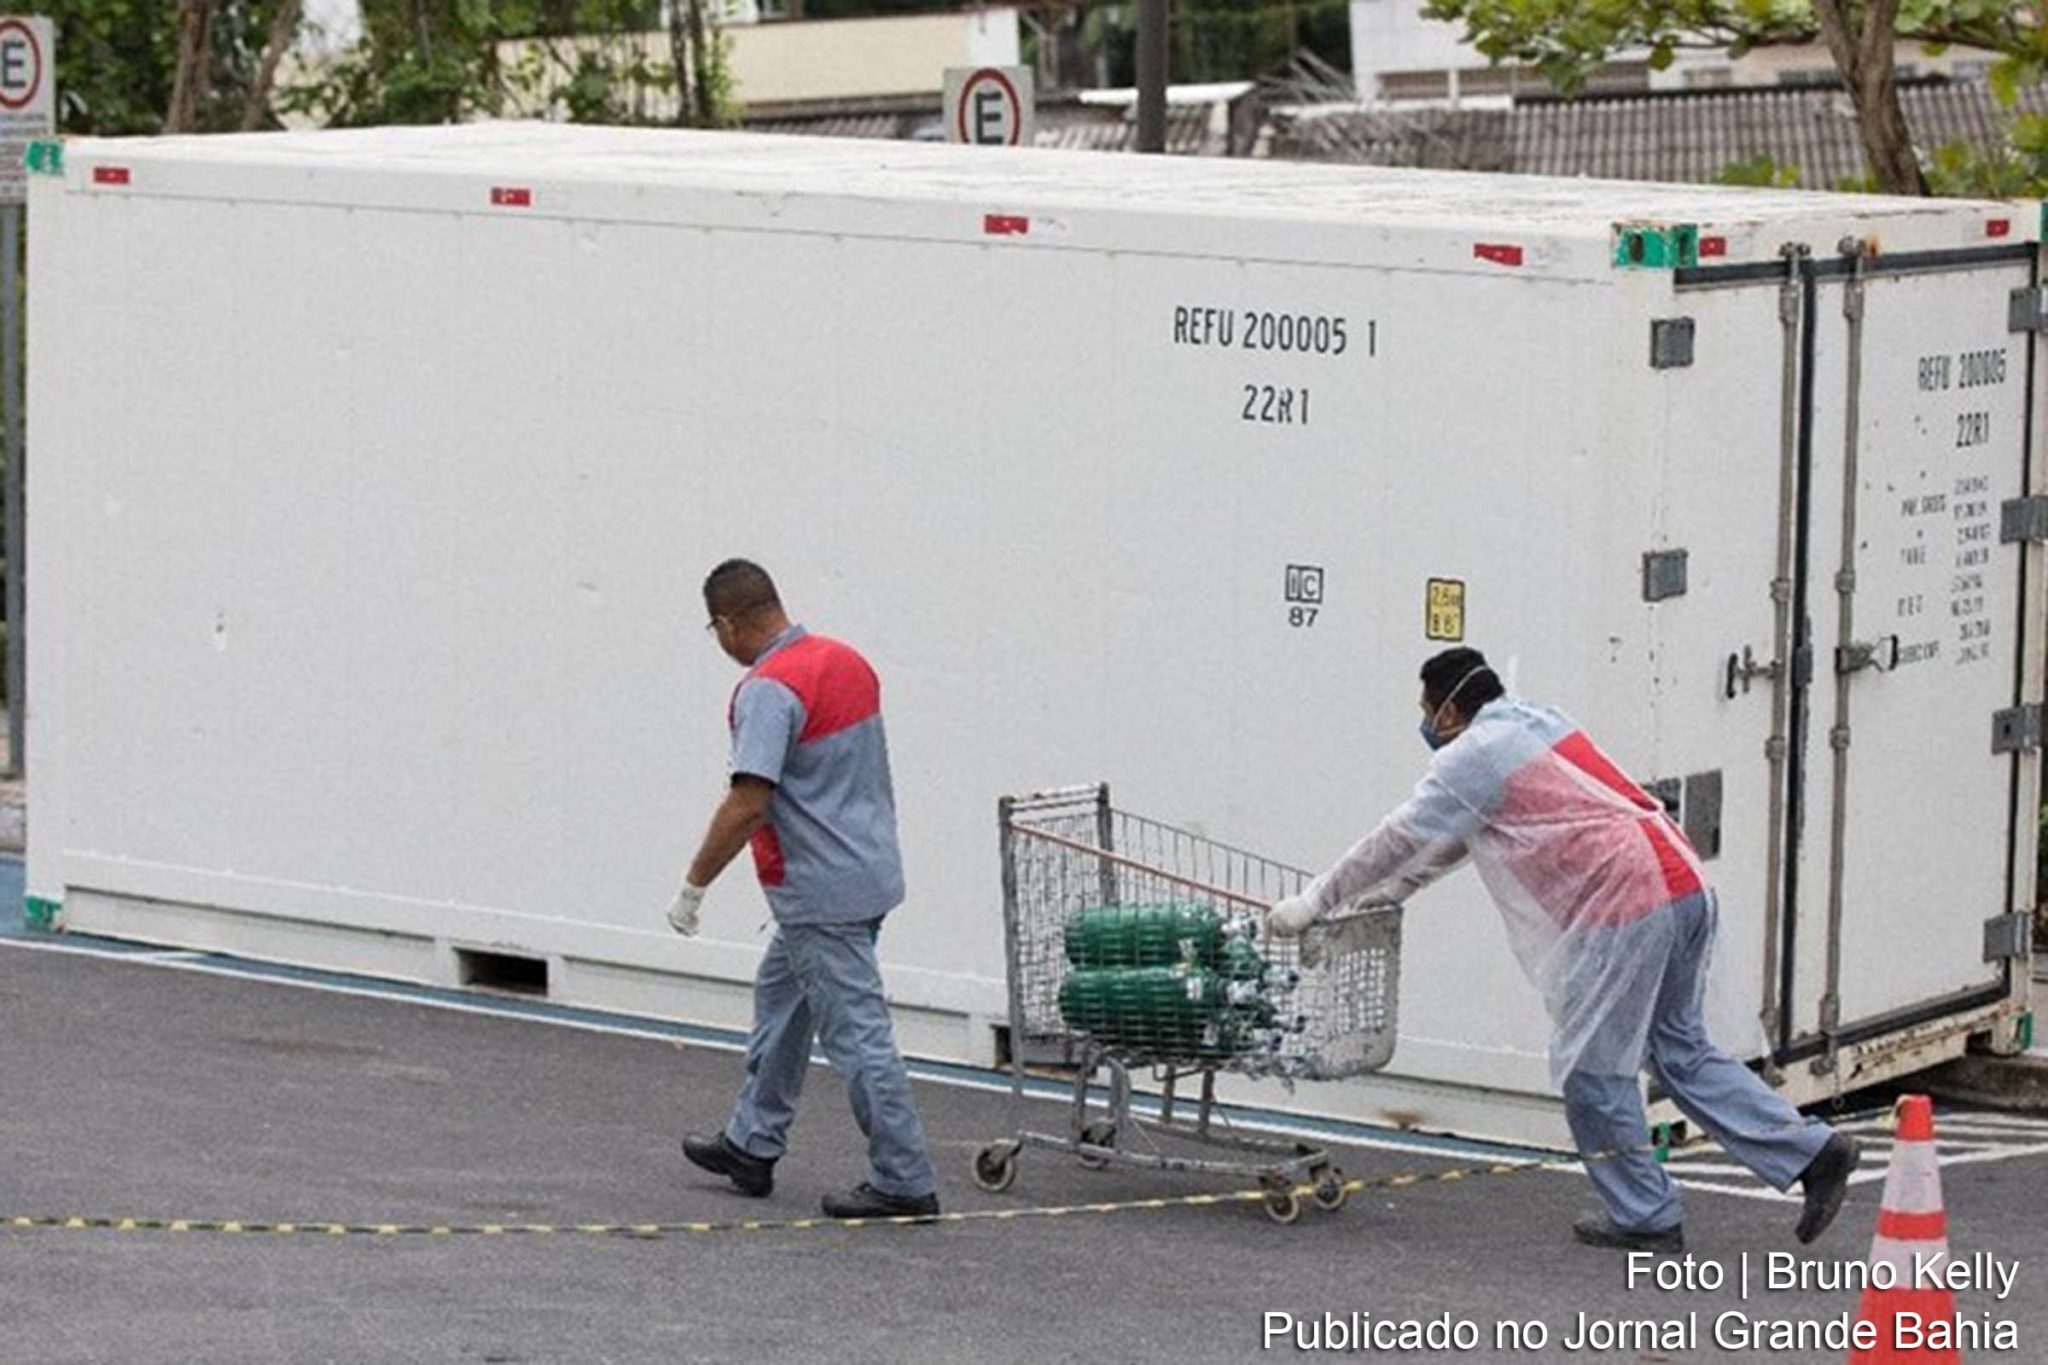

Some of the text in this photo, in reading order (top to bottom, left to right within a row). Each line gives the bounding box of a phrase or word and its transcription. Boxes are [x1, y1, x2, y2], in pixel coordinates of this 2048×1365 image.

[3, 40, 26, 88] E
[975, 91, 1004, 145] E
[1174, 305, 1377, 357] REFU 200005 1
[1242, 383, 1310, 425] 22R1
[1956, 411, 1990, 448] 22R1
[1288, 606, 1319, 628] 87
